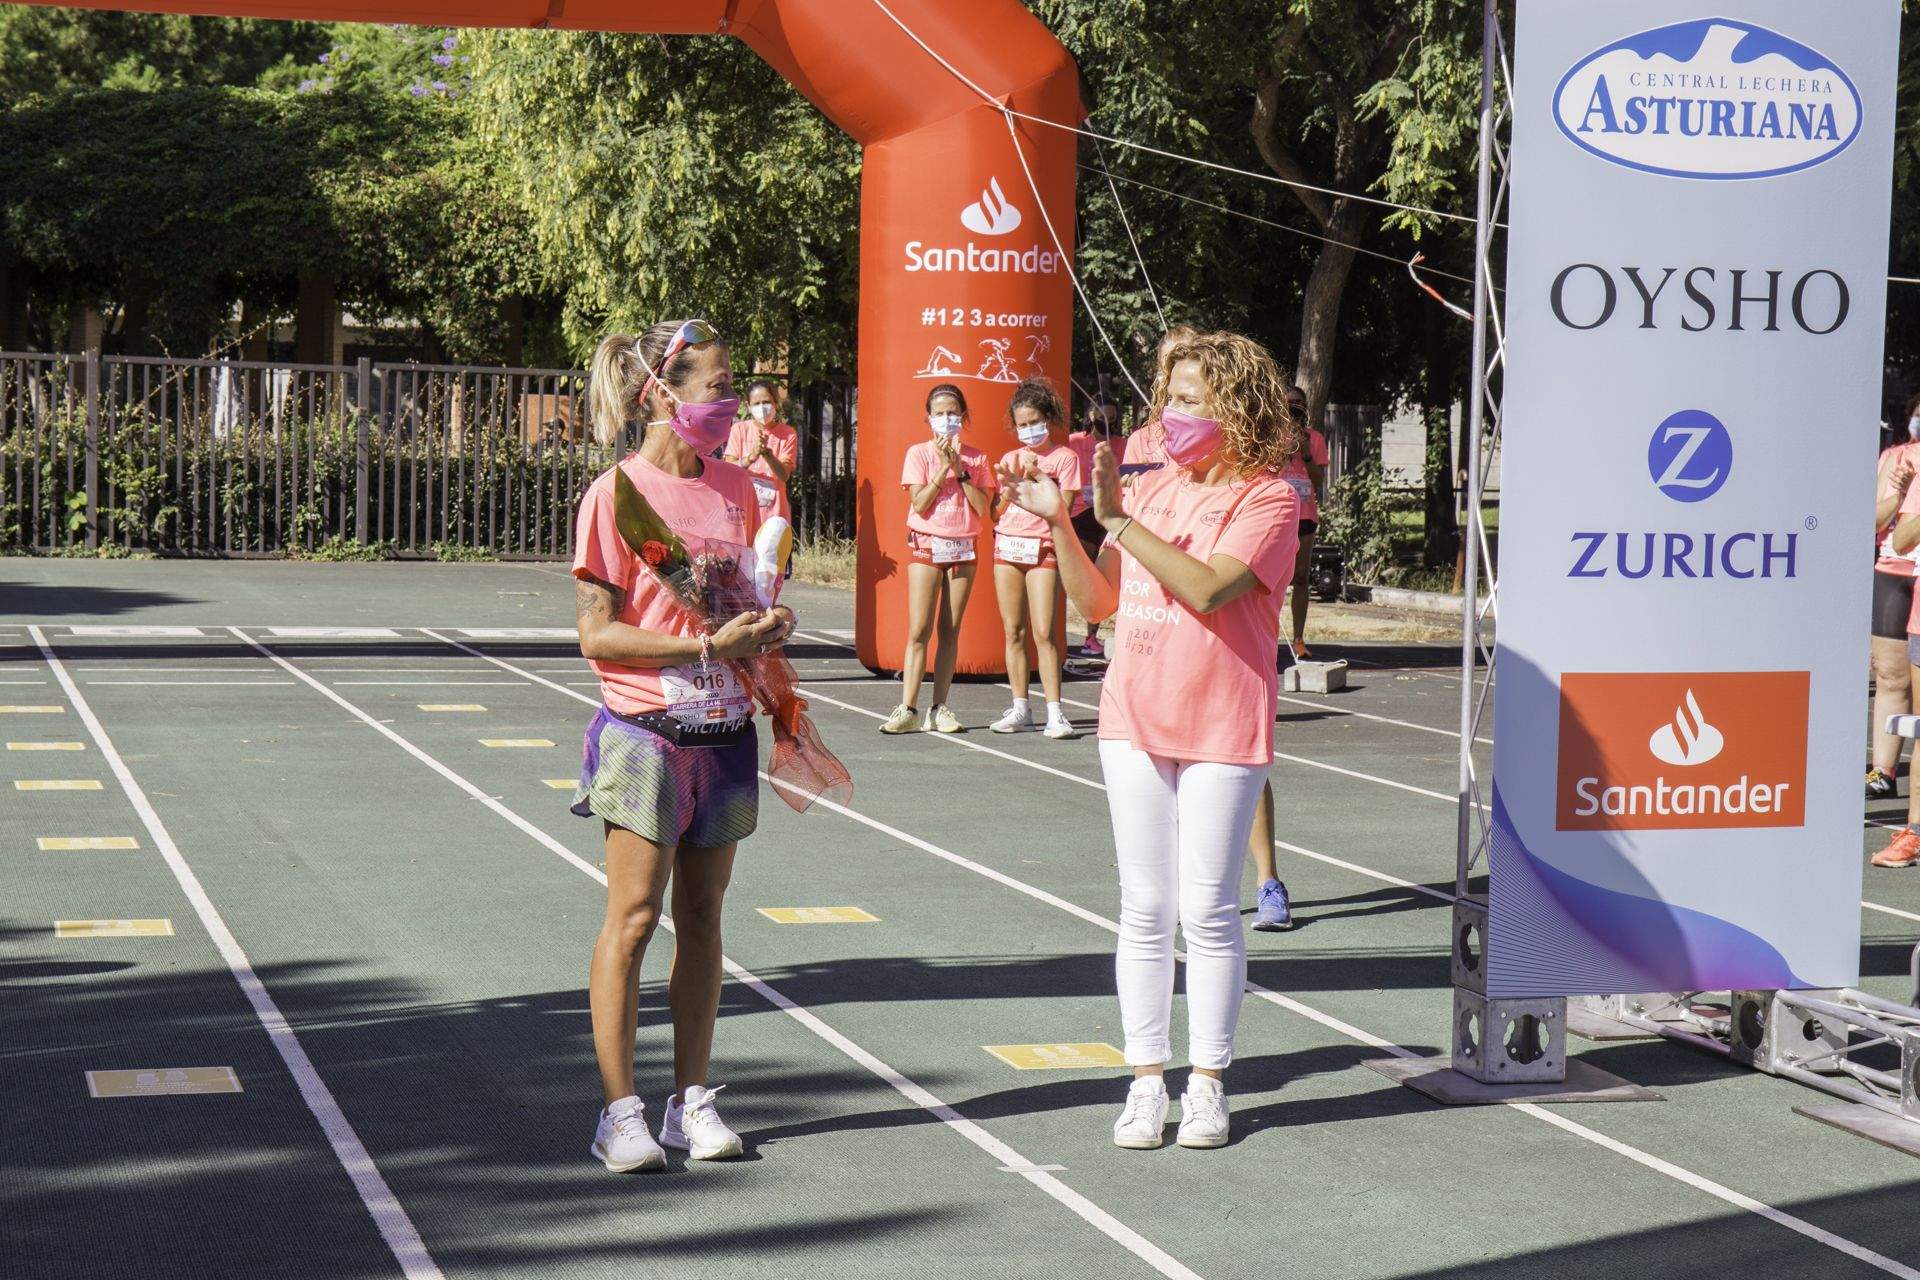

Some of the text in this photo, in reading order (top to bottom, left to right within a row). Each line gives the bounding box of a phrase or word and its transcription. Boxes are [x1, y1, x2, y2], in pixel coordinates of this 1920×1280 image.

[1630, 72, 1832, 93] CENTRAL LECHERA
[1577, 73, 1840, 141] ASTURIANA
[904, 241, 1061, 273] Santander
[1550, 263, 1850, 335] OYSHO
[1567, 532, 1799, 579] ZURICH
[1124, 579, 1150, 597] FOR
[1119, 601, 1181, 625] REASON
[693, 673, 725, 690] 016
[672, 702, 698, 711] CARRERA
[1575, 775, 1789, 818] Santander
